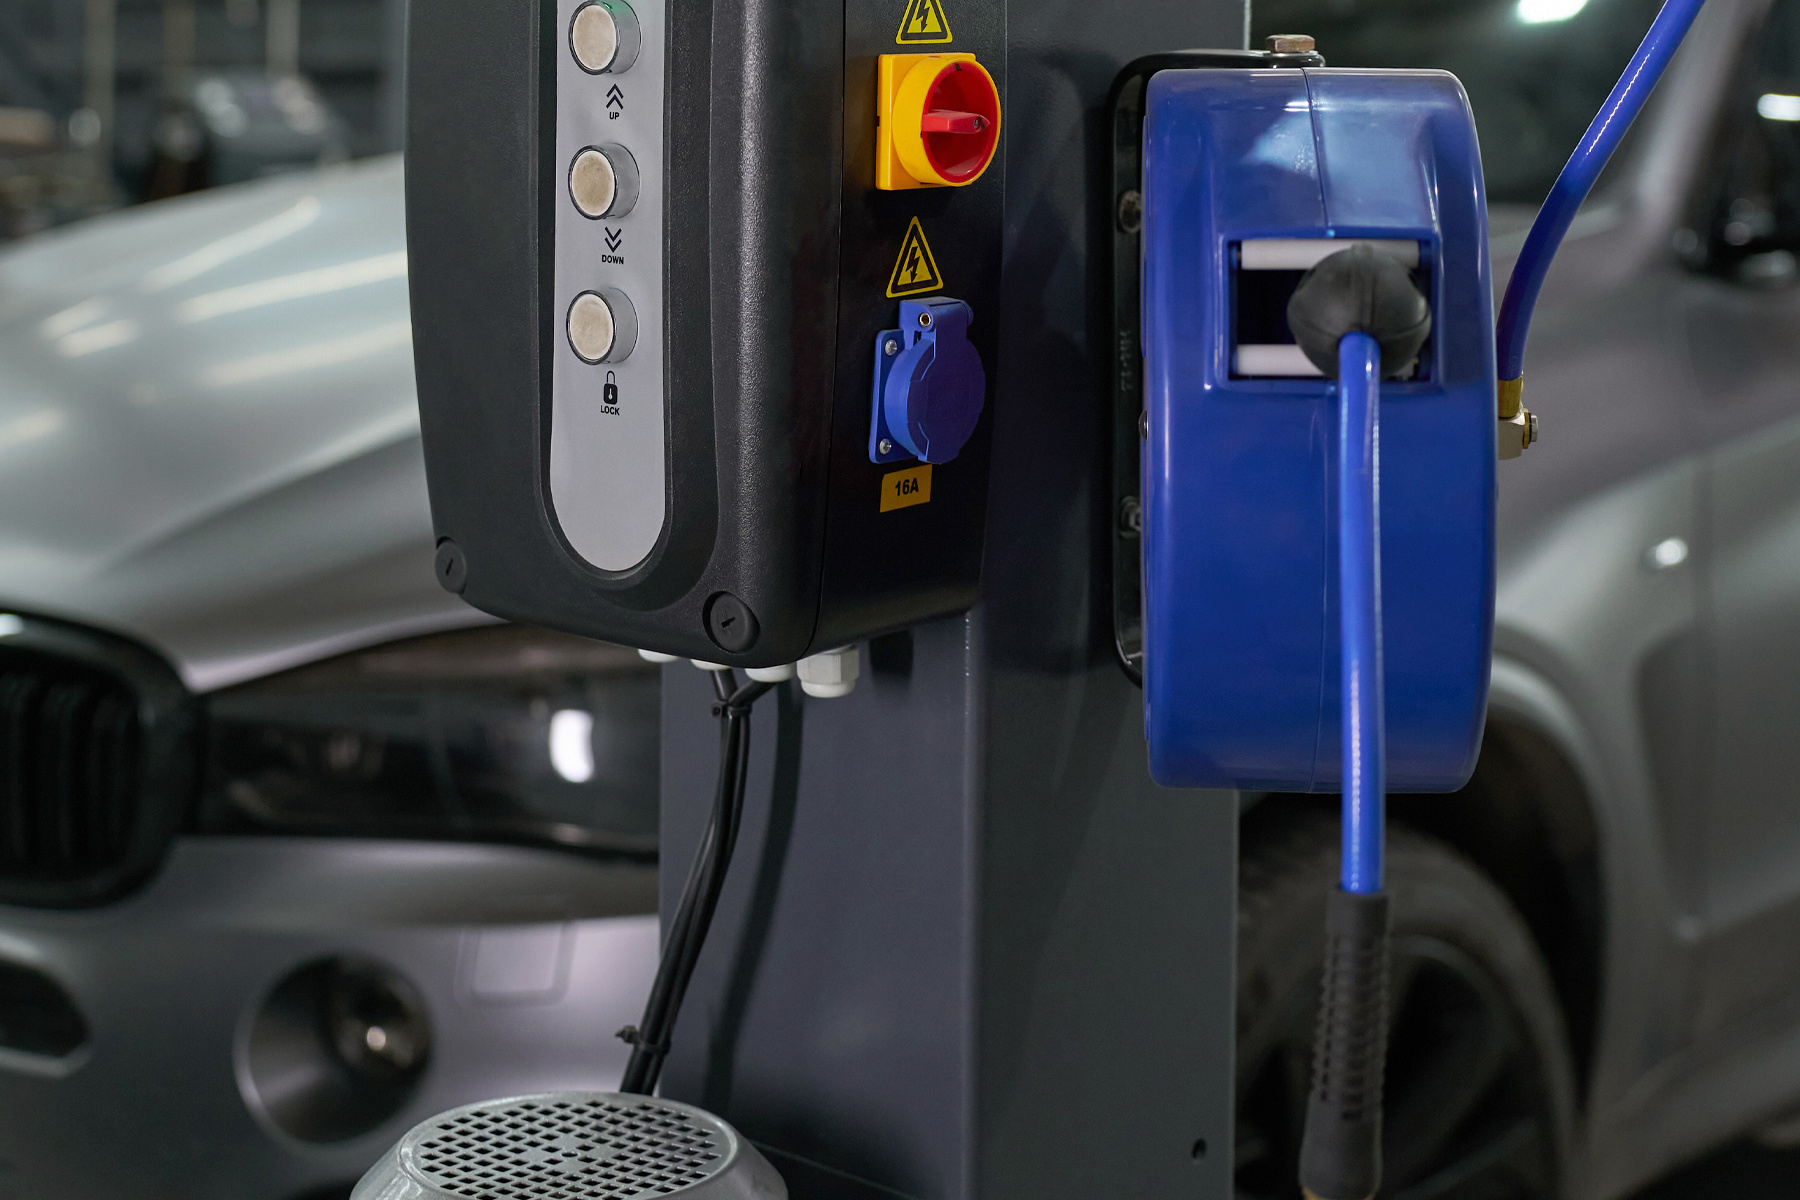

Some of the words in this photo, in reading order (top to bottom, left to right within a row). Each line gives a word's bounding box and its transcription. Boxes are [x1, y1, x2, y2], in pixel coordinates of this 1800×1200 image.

[609, 111, 620, 120] UP
[601, 254, 625, 265] DOWN
[600, 404, 620, 416] LOCK
[895, 477, 919, 496] 16A
